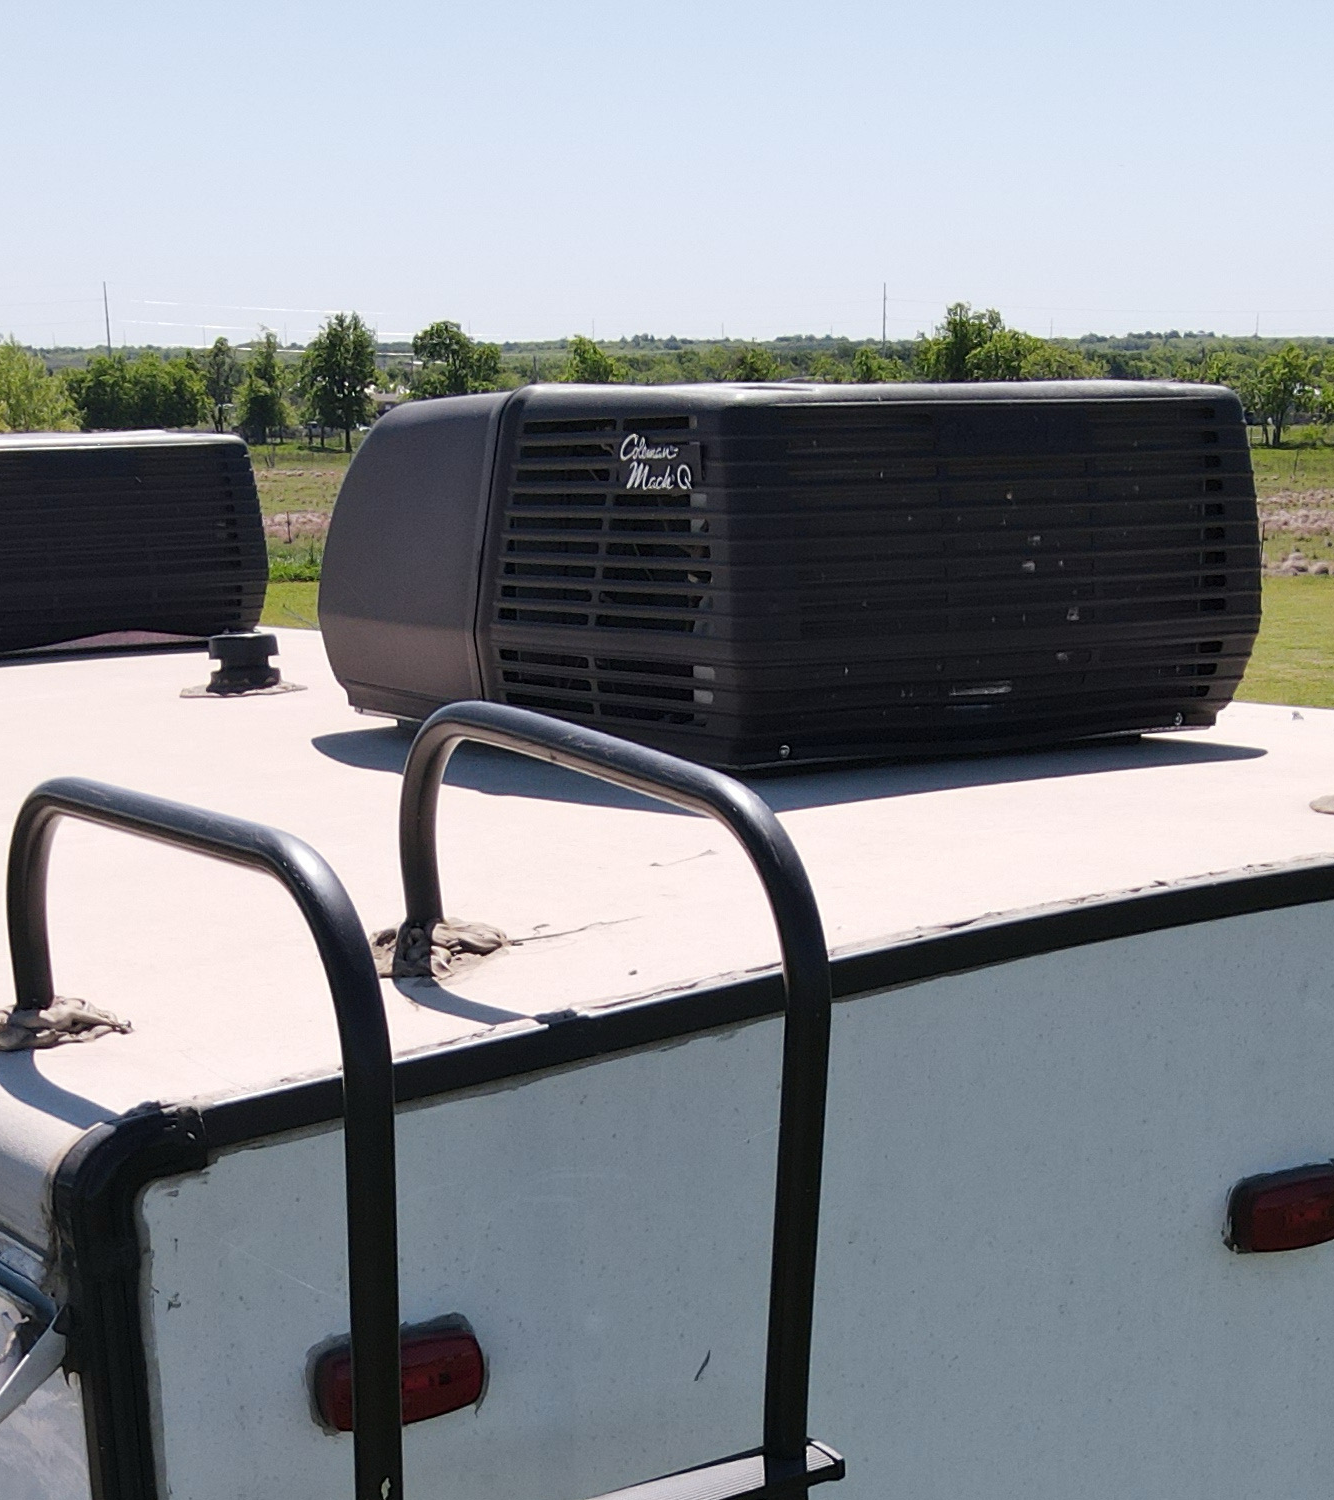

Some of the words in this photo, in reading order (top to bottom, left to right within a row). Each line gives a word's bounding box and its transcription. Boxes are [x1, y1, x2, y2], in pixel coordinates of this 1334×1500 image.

[620, 433, 679, 461] Coleman
[626, 461, 675, 490] Mach
[677, 464, 692, 490] Q
